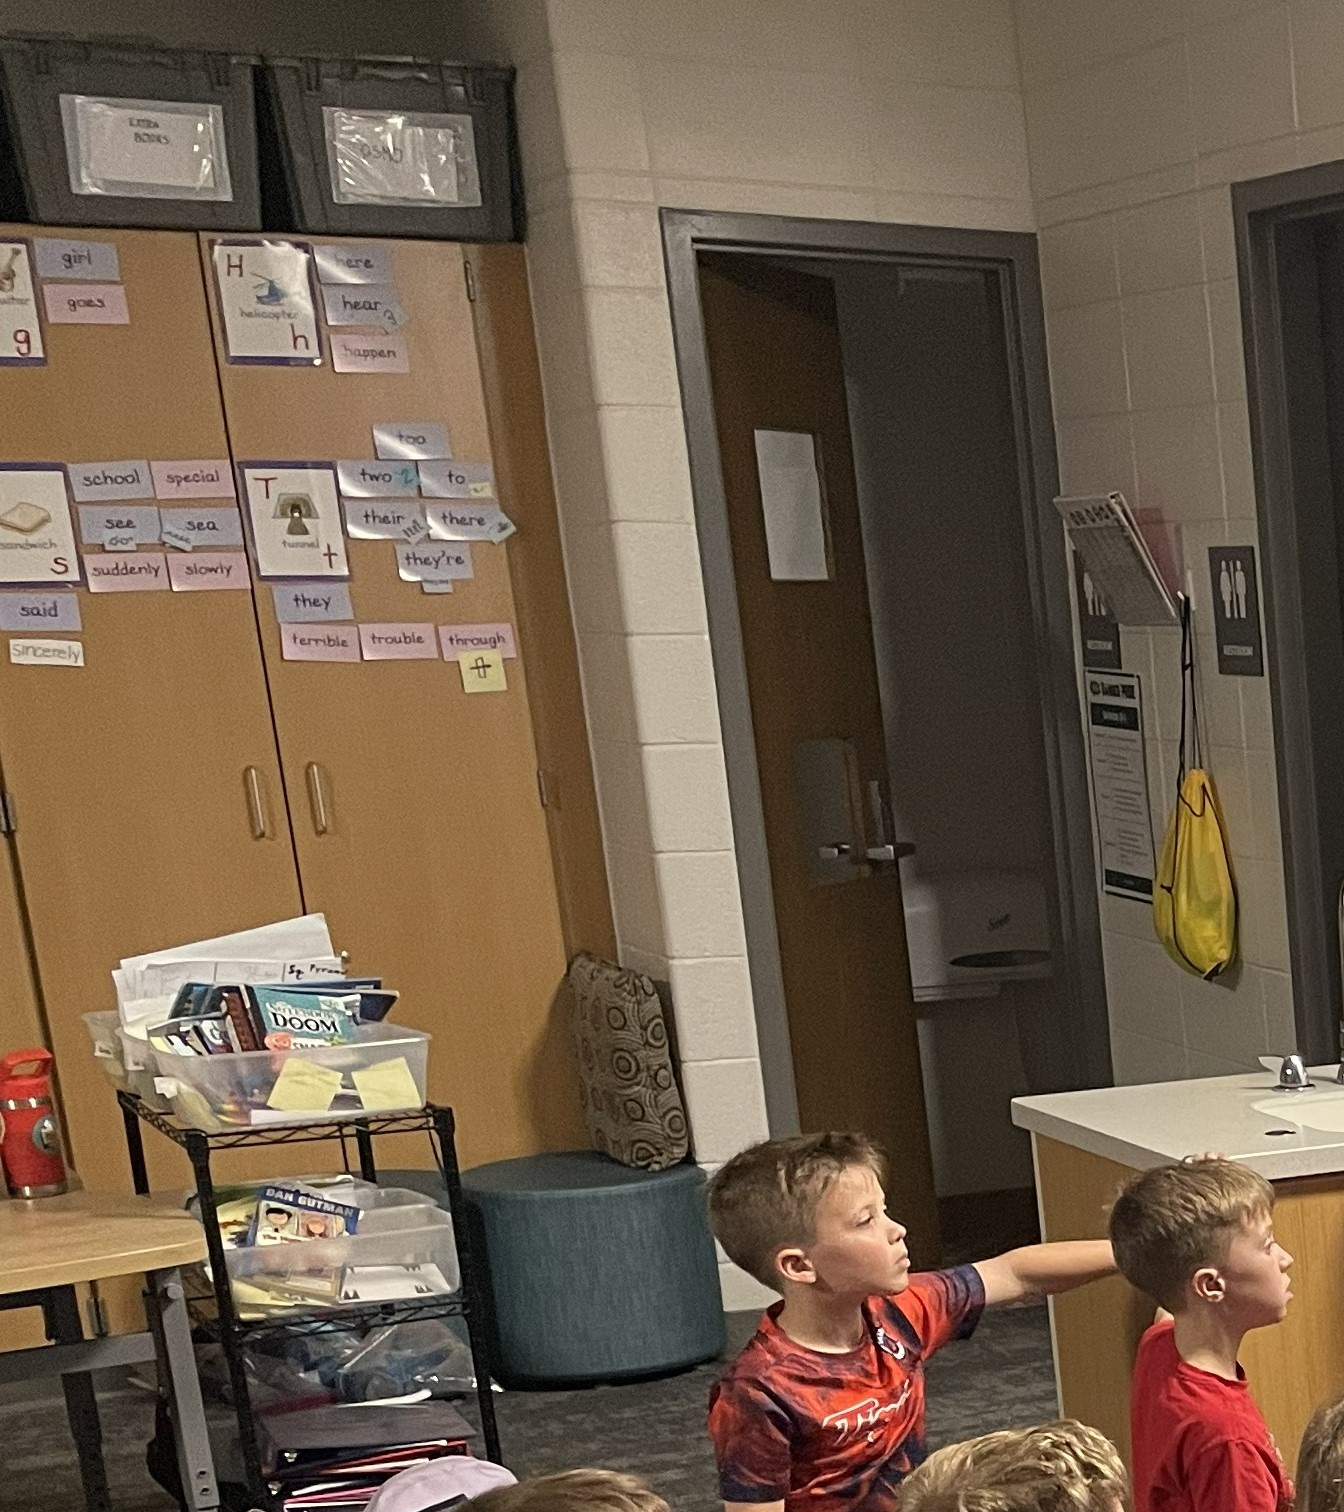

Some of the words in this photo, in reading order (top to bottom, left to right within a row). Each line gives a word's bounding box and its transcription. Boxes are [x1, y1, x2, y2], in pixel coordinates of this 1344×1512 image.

[61, 247, 92, 267] girl
[226, 253, 244, 278] H
[66, 296, 106, 311] goes
[342, 294, 381, 312] hear
[13, 328, 32, 357] g
[291, 323, 310, 350] h
[343, 343, 397, 362] happen
[397, 433, 426, 446] too
[83, 469, 141, 487] school
[166, 470, 220, 485] special
[360, 468, 393, 483] two
[447, 468, 466, 485] to
[253, 477, 279, 500] T
[104, 518, 137, 529] see
[185, 519, 219, 532] sea
[363, 510, 406, 525] their
[441, 511, 486, 527] there
[281, 537, 320, 549] tunnel
[322, 543, 339, 569] t
[404, 550, 465, 569] they're
[91, 561, 161, 579] suddenly
[184, 561, 233, 578] slowly
[19, 601, 58, 619] said
[294, 594, 331, 611] they
[292, 631, 349, 649] terrible
[371, 628, 425, 645] trouble
[448, 630, 506, 649] through
[271, 1010, 341, 1035] DOOM
[265, 1187, 294, 1203] DAN
[297, 1195, 355, 1217] GUTMAN
